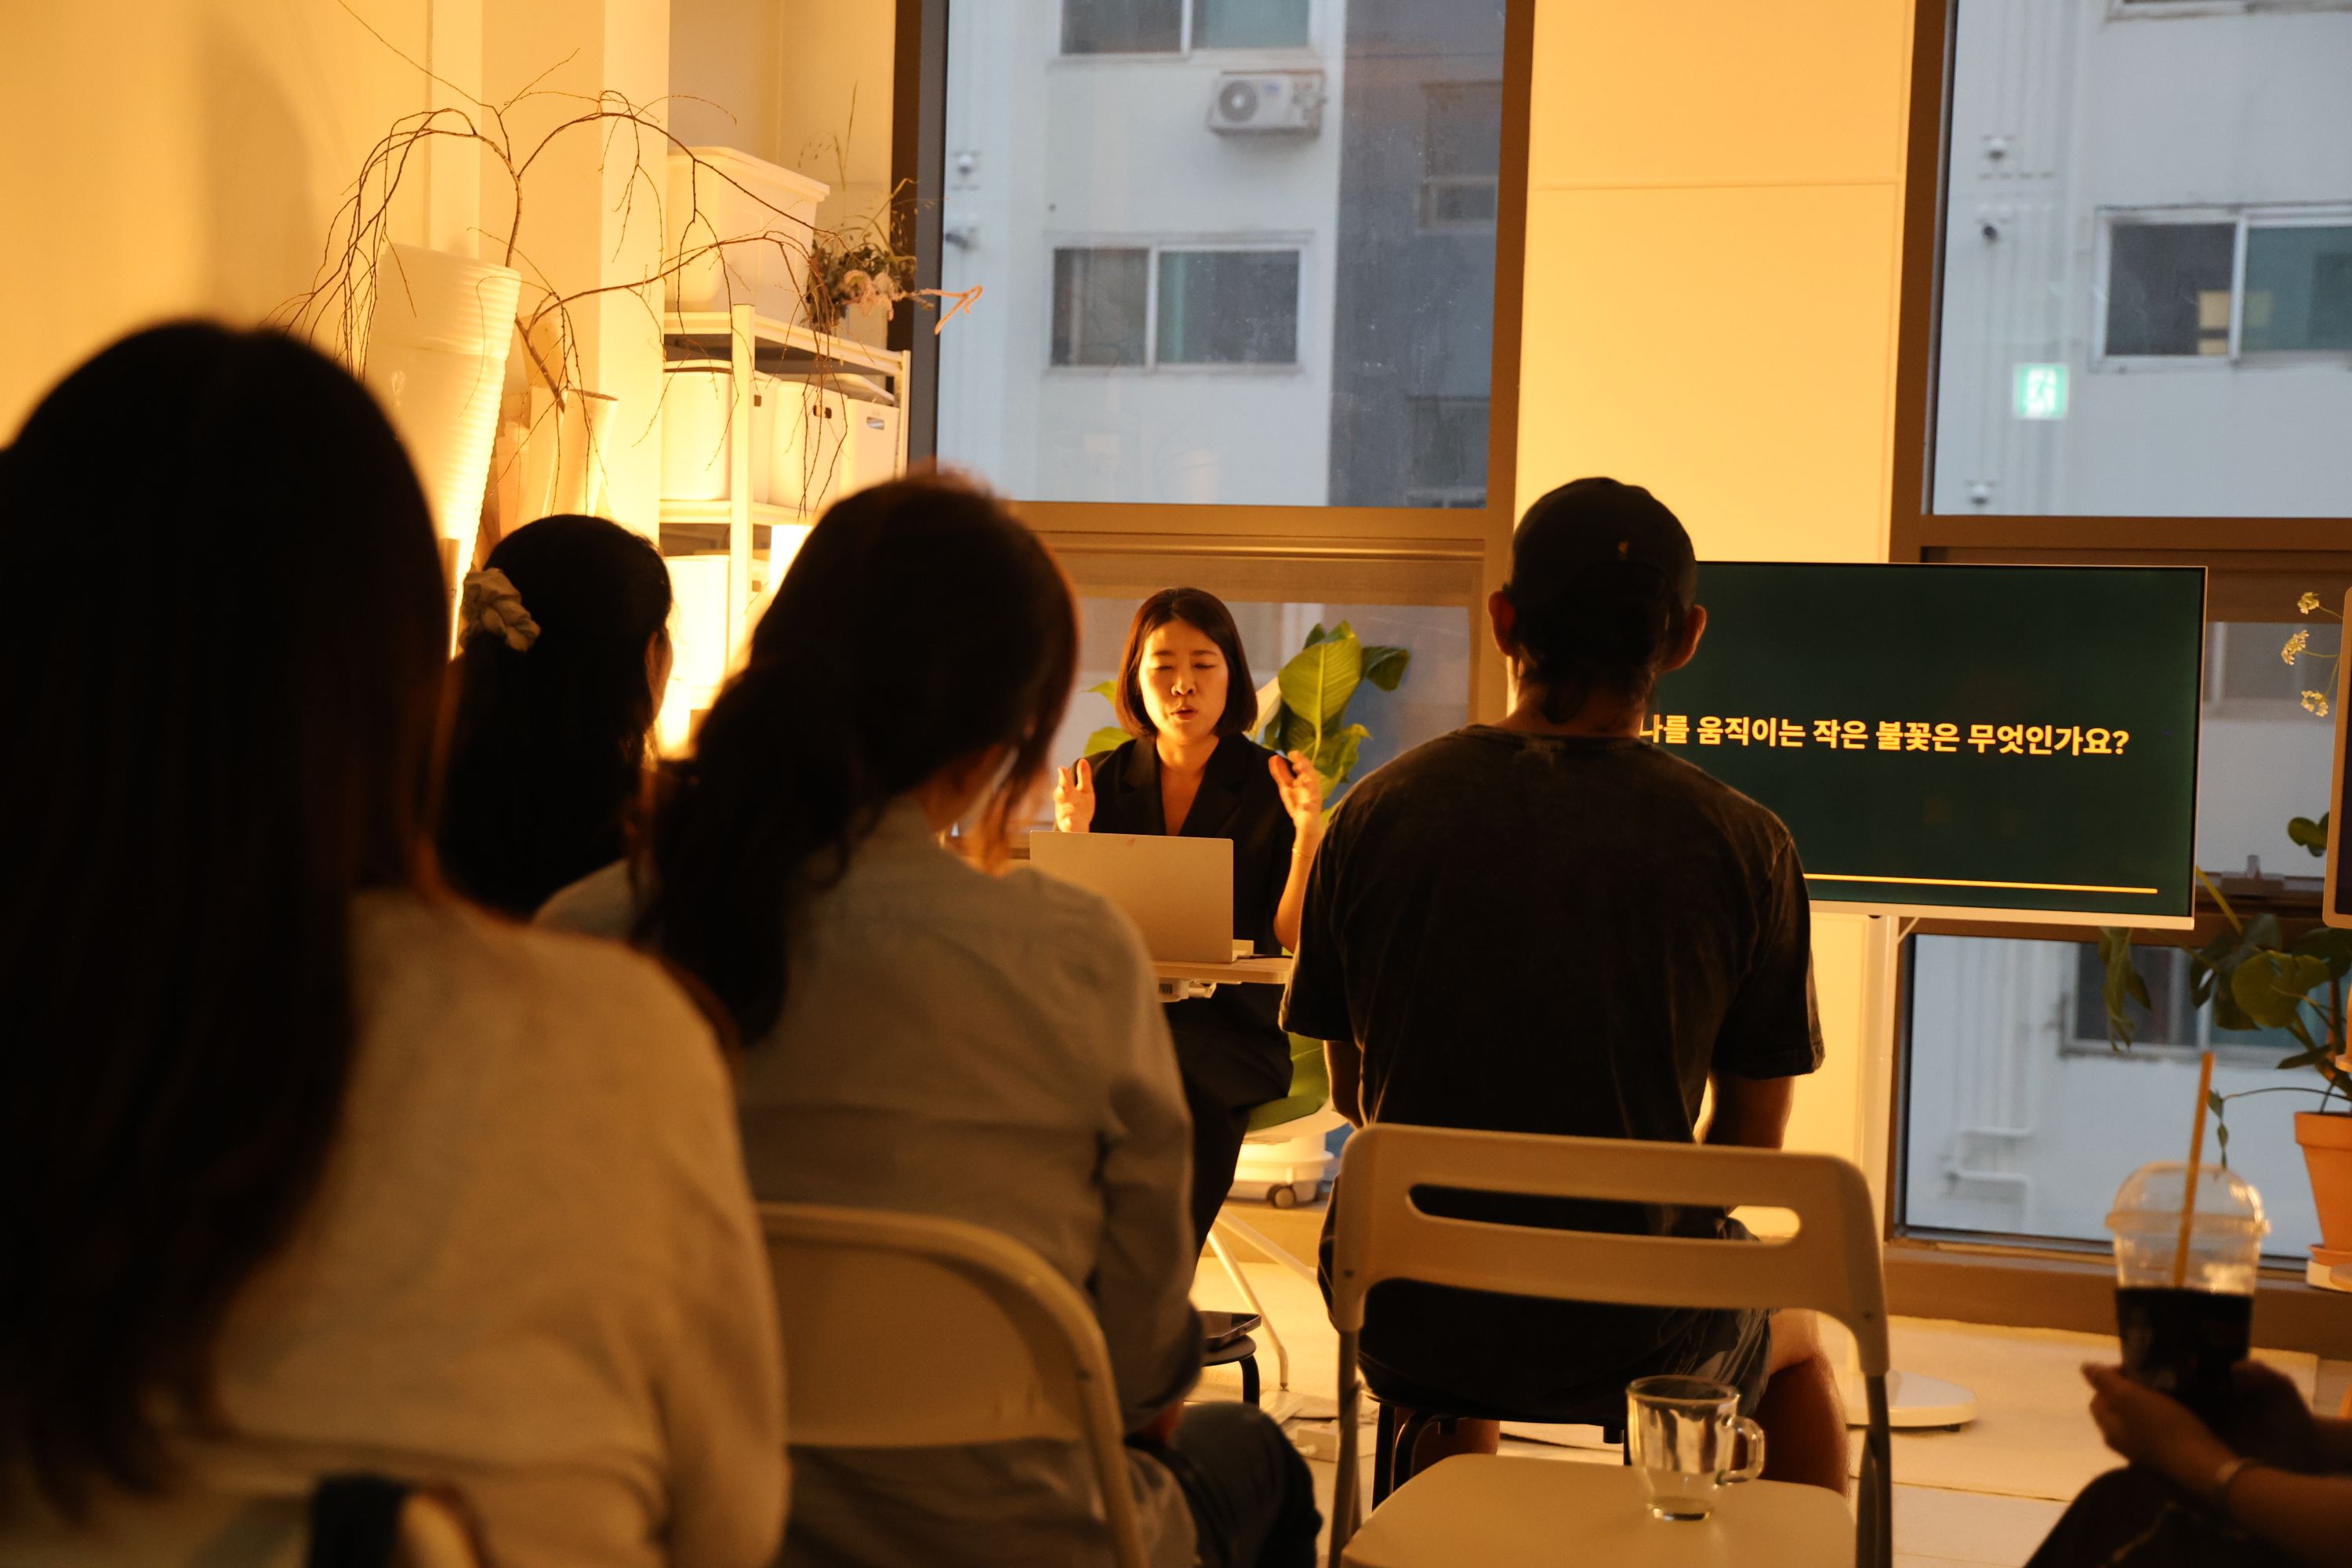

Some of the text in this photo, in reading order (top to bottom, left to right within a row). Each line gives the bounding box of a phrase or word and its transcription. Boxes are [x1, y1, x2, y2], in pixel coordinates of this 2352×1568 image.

[1697, 716, 1806, 747] 움직이는
[1813, 719, 1869, 750] 작은
[1875, 720, 1961, 753] 불꽃은
[1967, 724, 2129, 757] 무엇인가요?
